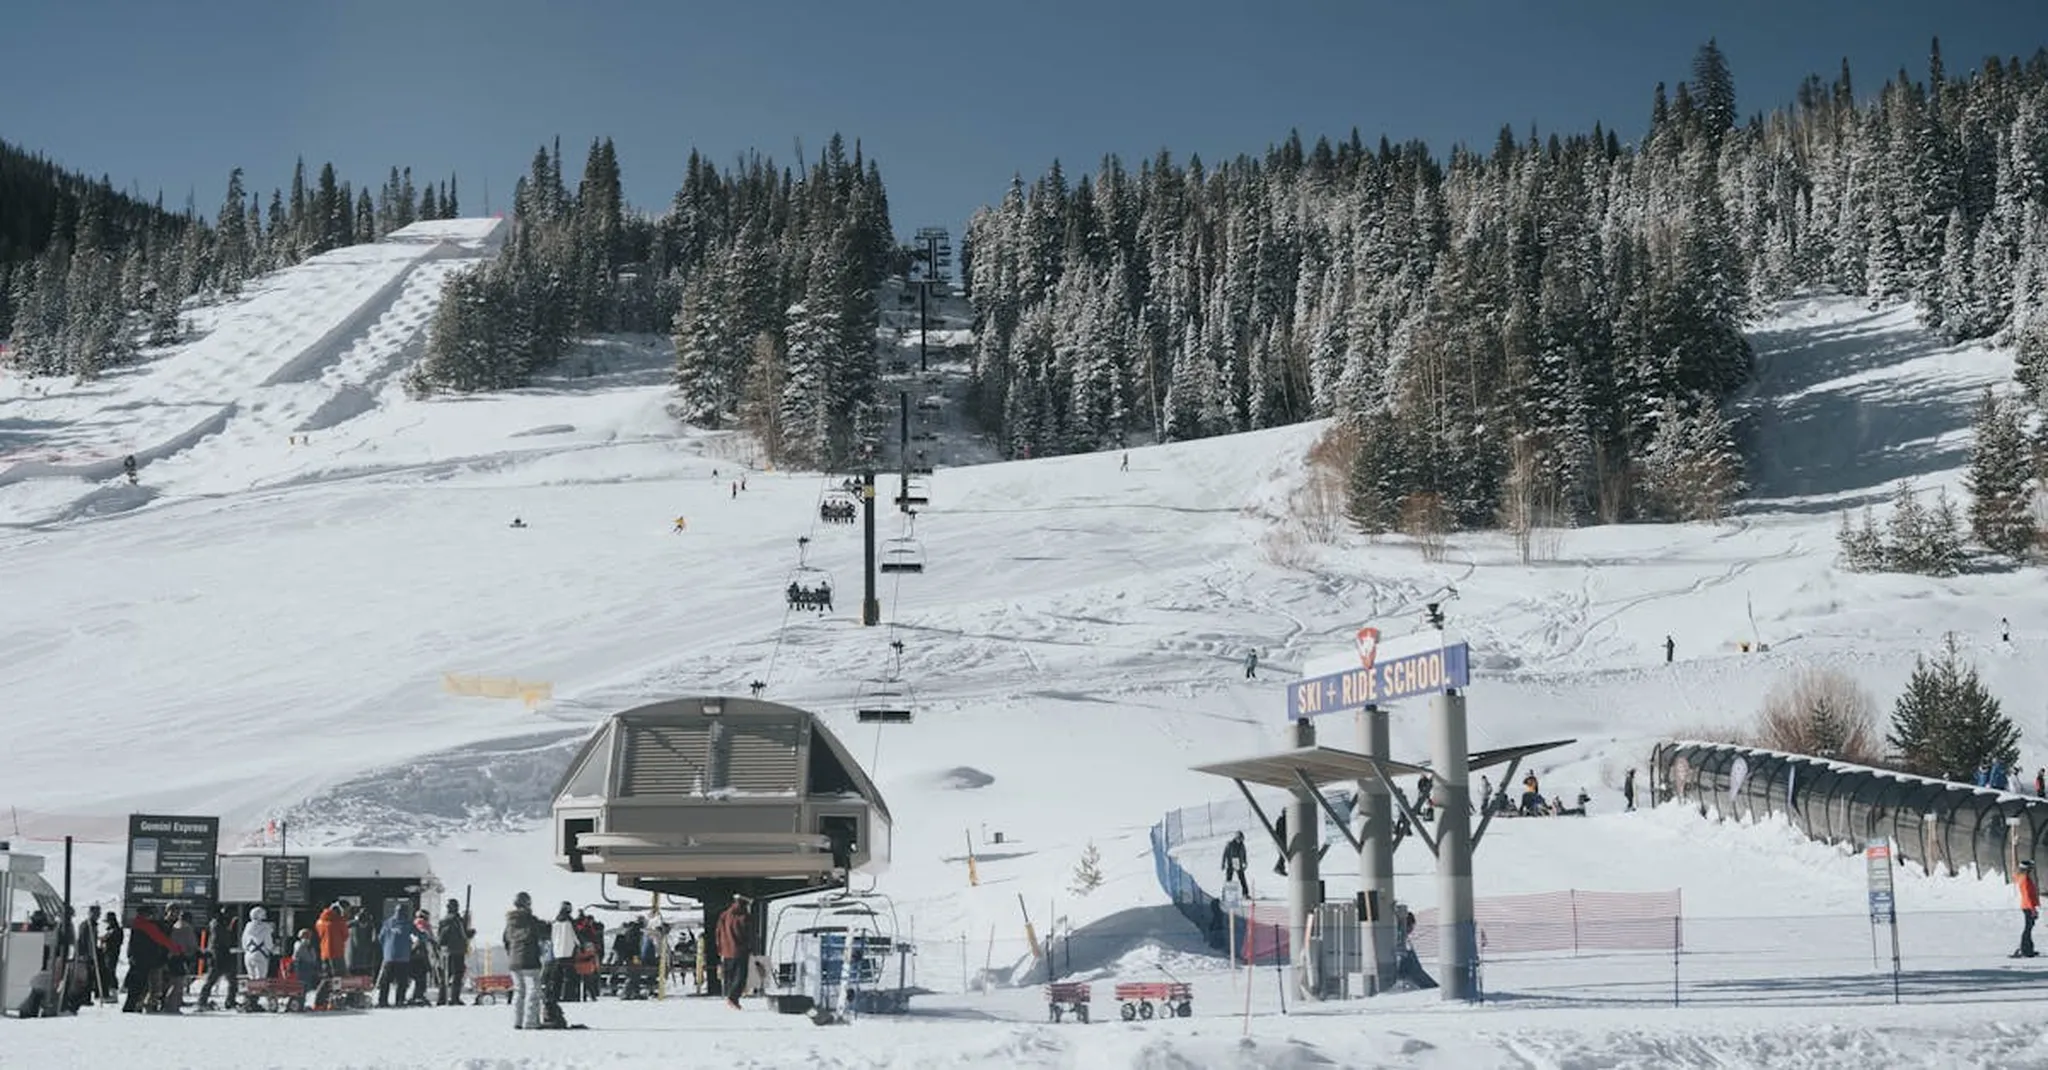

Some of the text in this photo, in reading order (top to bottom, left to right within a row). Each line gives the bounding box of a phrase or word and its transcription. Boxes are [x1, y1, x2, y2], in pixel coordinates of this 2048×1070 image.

[1298, 654, 1451, 714] SKI + RIDE SCHOOL
[140, 820, 209, 834] Gemini Express
